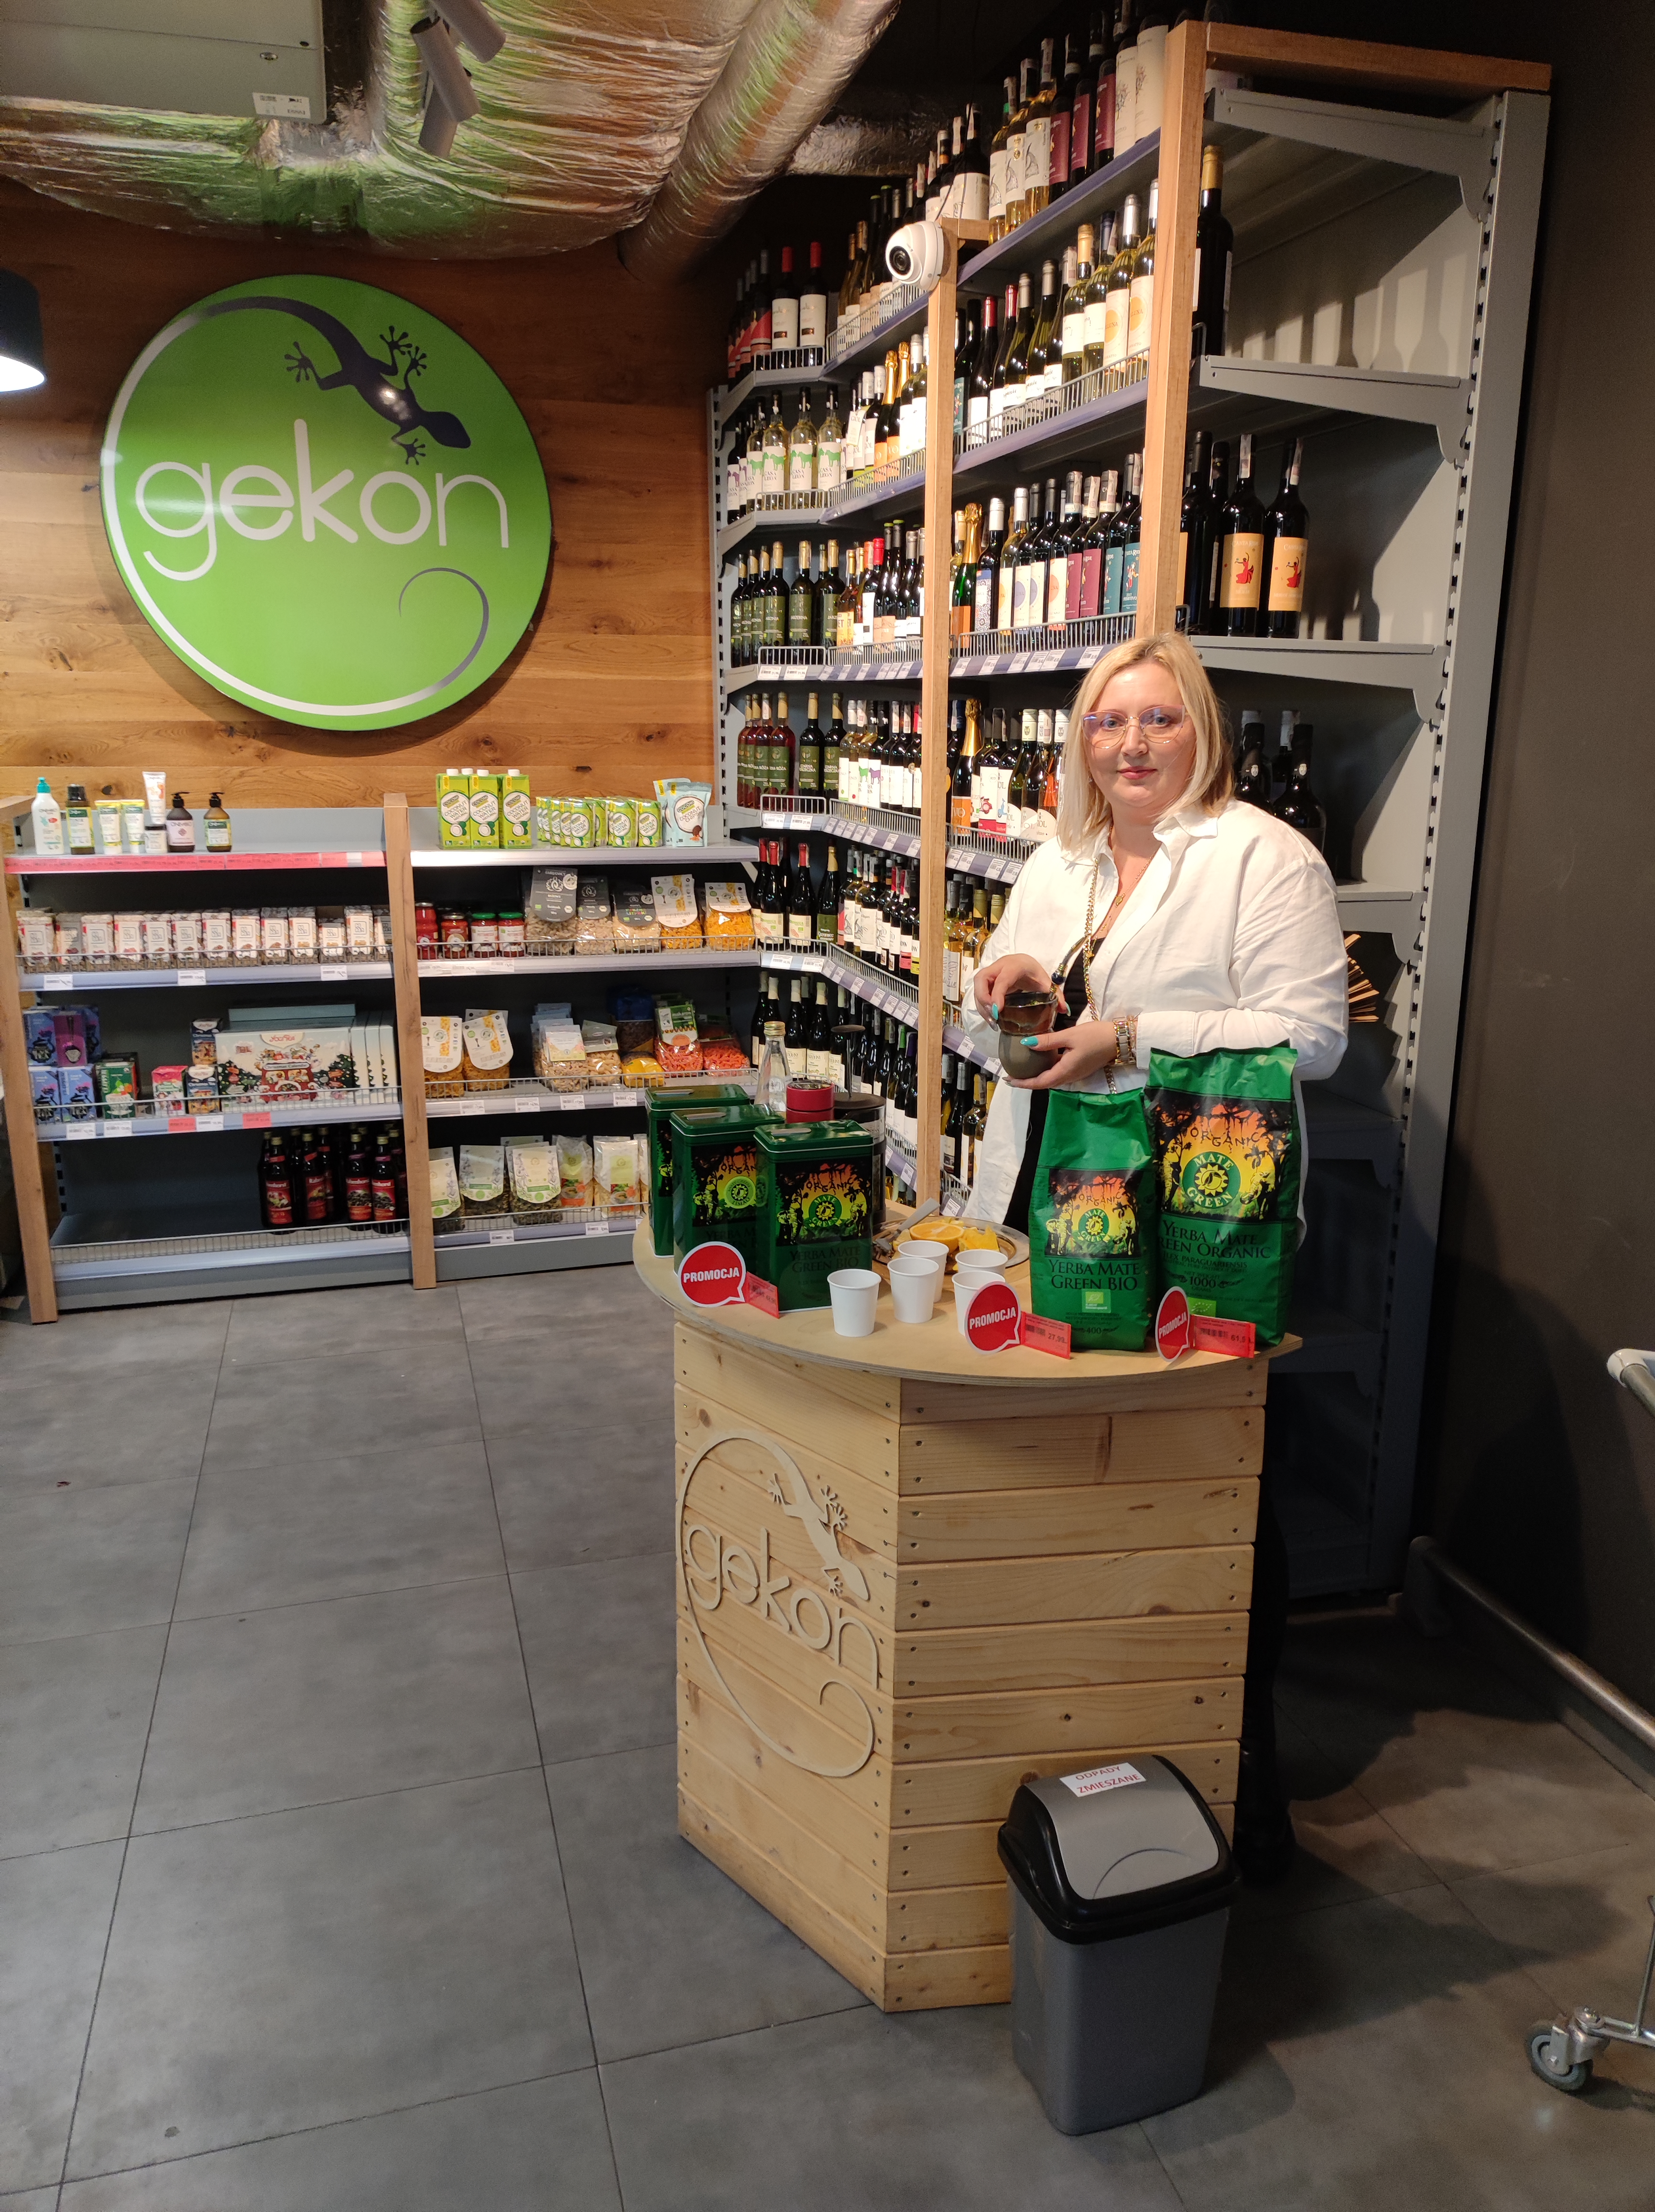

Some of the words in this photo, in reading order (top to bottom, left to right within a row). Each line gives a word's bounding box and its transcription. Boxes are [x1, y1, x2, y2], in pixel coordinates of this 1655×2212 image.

[135, 419, 509, 581] gekon
[444, 800, 468, 817] COCONUT
[449, 808, 467, 819] WATER
[473, 800, 496, 817] COCONUT
[478, 808, 496, 819] WATER
[507, 799, 530, 817] COCONUT
[511, 807, 529, 819] WATER
[680, 806, 701, 821] COCONUT
[1190, 1127, 1260, 1147] ORGANIC
[721, 1164, 756, 1175] ORGAN
[1193, 1153, 1234, 1170] MATE
[806, 1177, 854, 1193] ORGANIC
[814, 1195, 838, 1204] MATE
[1078, 1191, 1121, 1206] ORGANIC
[1187, 1187, 1233, 1208] GREEN
[1085, 1208, 1106, 1219] MATE
[812, 1217, 838, 1227] GREEN
[1081, 1230, 1106, 1242] GREEN
[1163, 1219, 1207, 1241] YERBA
[1214, 1229, 1257, 1246] MATE
[790, 1249, 826, 1261] YERBA
[830, 1246, 861, 1258] MATE
[1197, 1243, 1271, 1259] ORGANIC
[792, 1261, 831, 1273] GREEN
[837, 1257, 858, 1269] BIO
[1049, 1260, 1094, 1275] YERBA
[1098, 1262, 1141, 1276] MATE
[683, 1267, 740, 1283] PROMOCJA
[1051, 1275, 1102, 1290] GREEN
[1108, 1277, 1138, 1290] BIO
[1190, 1276, 1216, 1288] 1000
[969, 1307, 1016, 1330] PROMOCJA
[1158, 1311, 1187, 1339] PROMOCJA
[686, 1524, 879, 1690] gekon
[1075, 1765, 1121, 1781] ODPADY
[1076, 1773, 1141, 1794] ZMIESZANE
